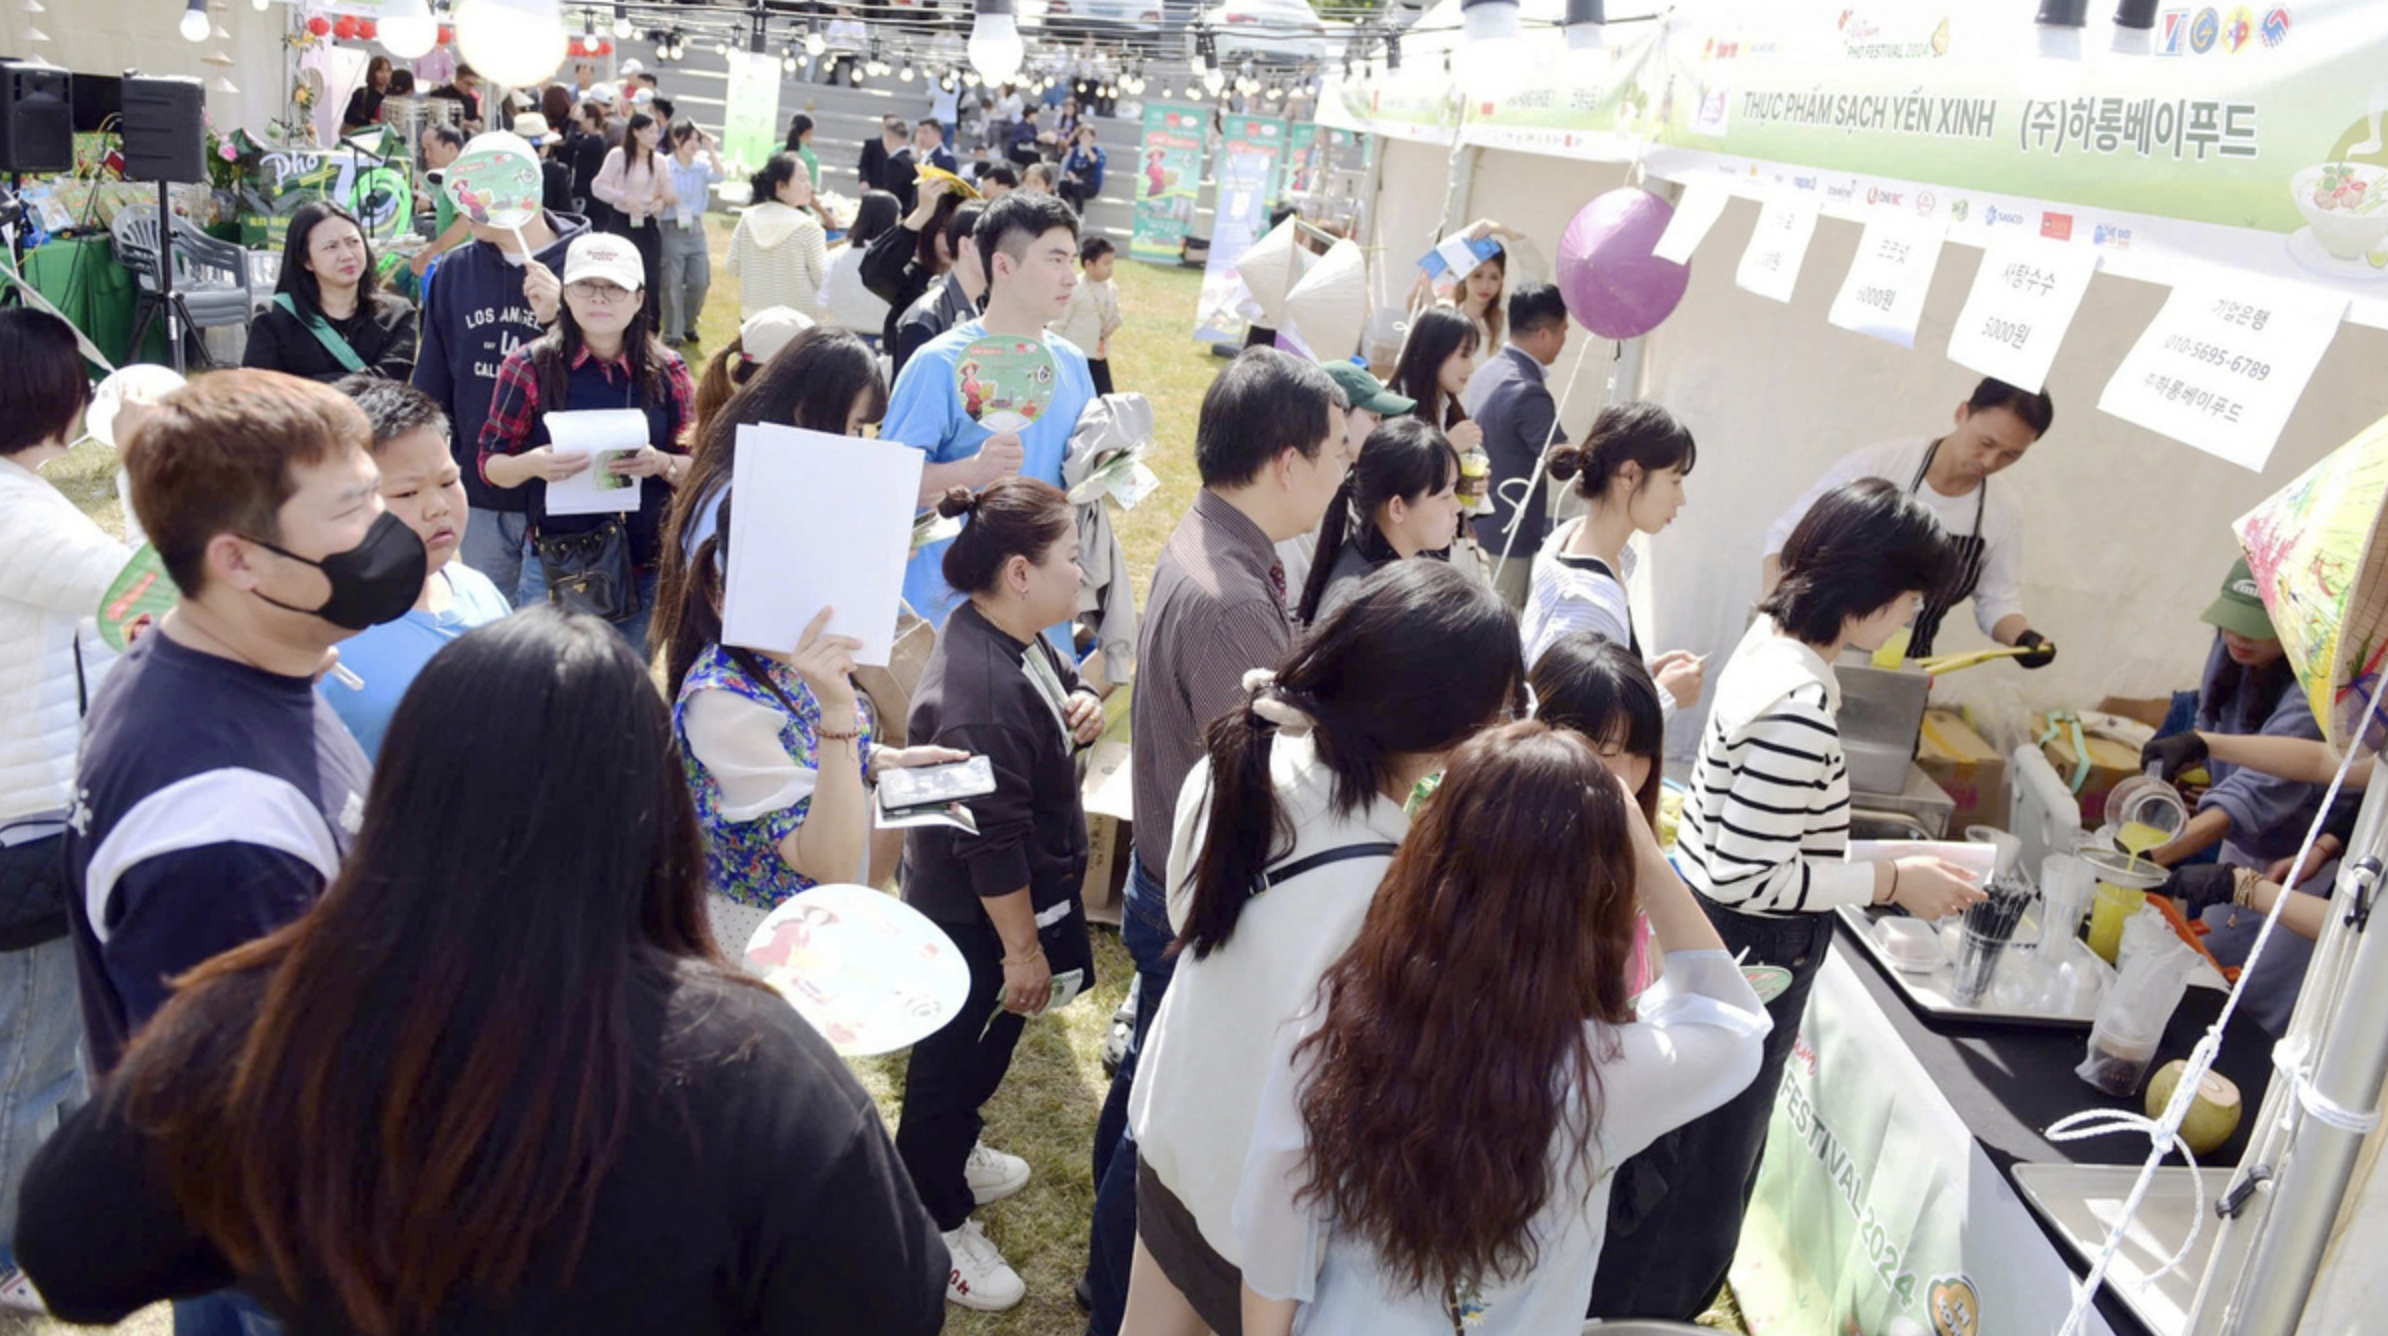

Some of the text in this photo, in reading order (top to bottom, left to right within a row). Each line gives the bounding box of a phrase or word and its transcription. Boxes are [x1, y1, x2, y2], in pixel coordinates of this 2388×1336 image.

[1835, 94, 1888, 135] SẠCH
[1892, 86, 1934, 132] YẾN
[1936, 98, 1996, 138] XINH
[2021, 96, 2257, 159] (주)하롱베이푸드
[1998, 211, 2024, 226] SASCO
[2002, 263, 2056, 297] 사탕수수
[465, 307, 495, 330] LOS
[2211, 299, 2271, 331] 기업은행
[1982, 316, 2032, 350] 5000원
[2163, 333, 2272, 382] 010-5695-6789
[1779, 1070, 1916, 1306] FESTIVAL 2024
